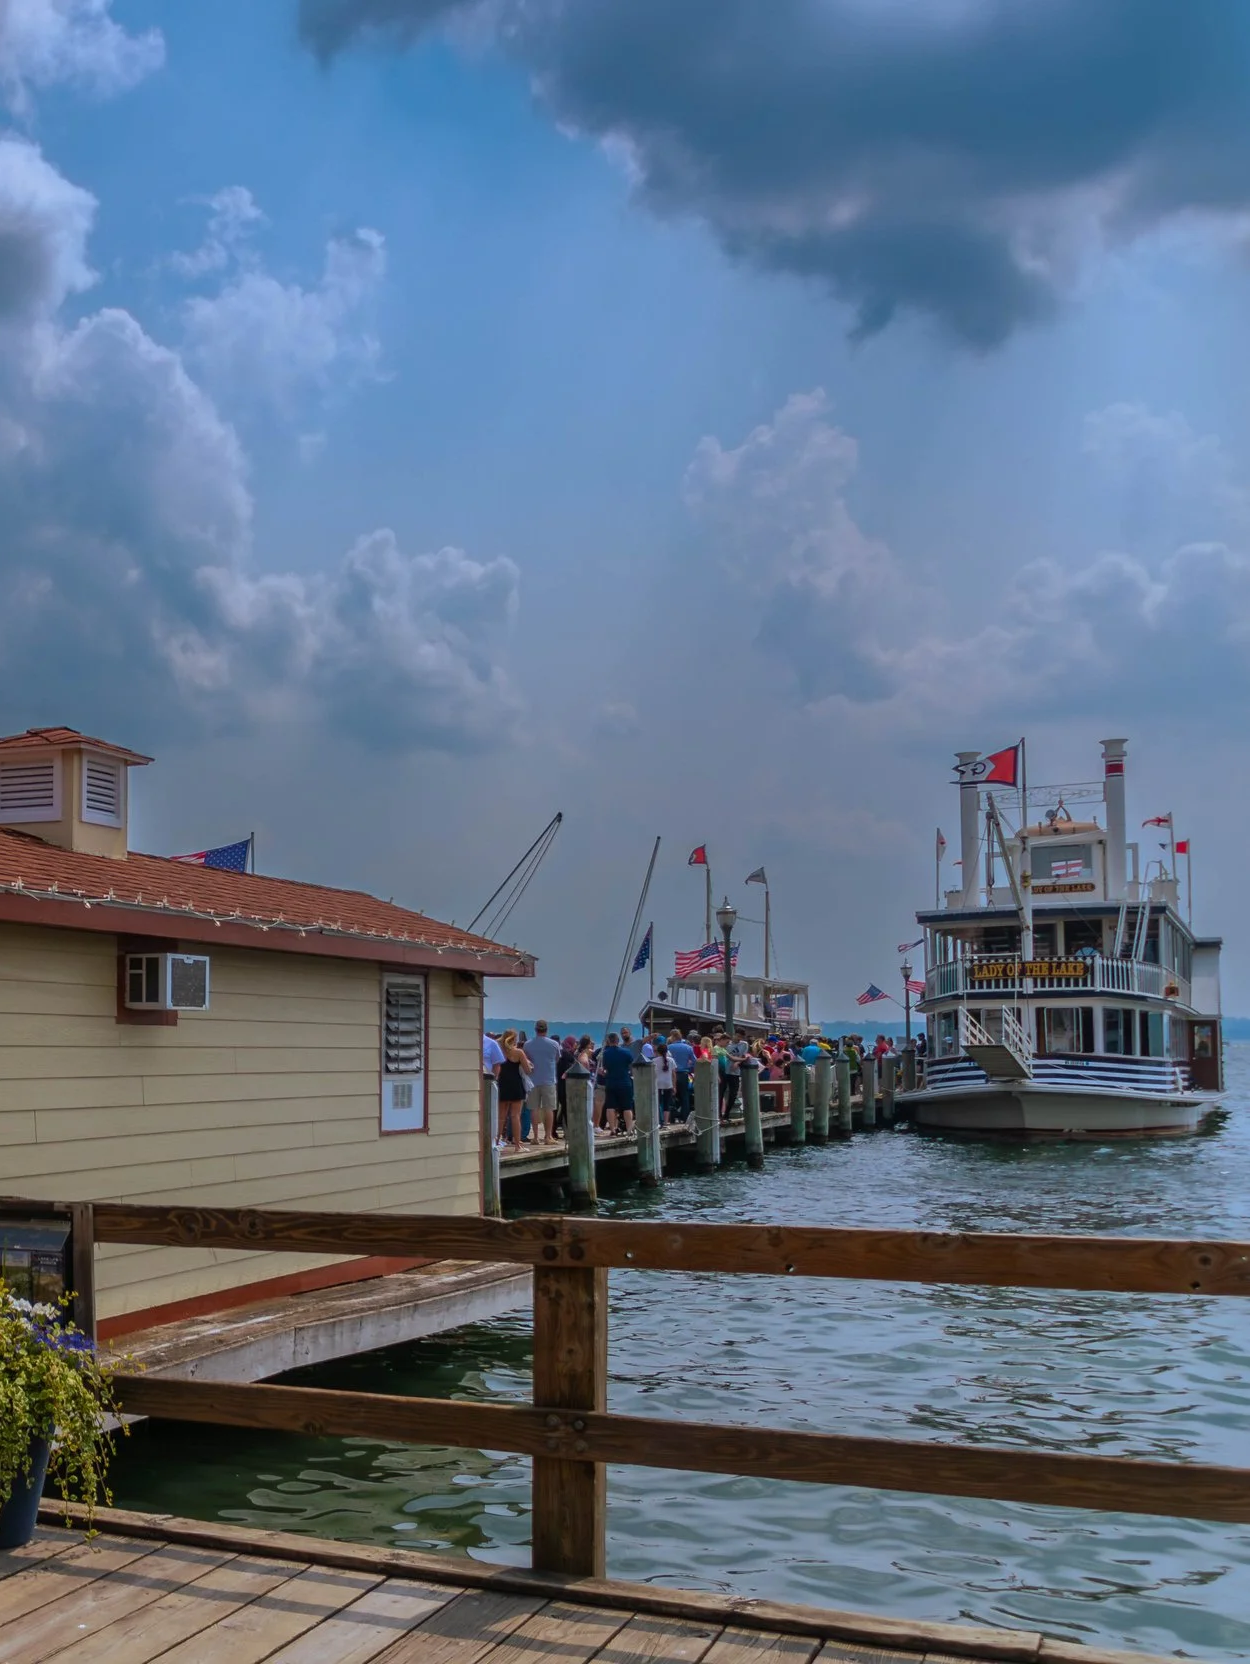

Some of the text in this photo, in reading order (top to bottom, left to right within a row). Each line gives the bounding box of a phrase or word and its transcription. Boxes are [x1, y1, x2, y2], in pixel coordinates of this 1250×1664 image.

[973, 961, 1085, 979] LADY OF THE LAKE
